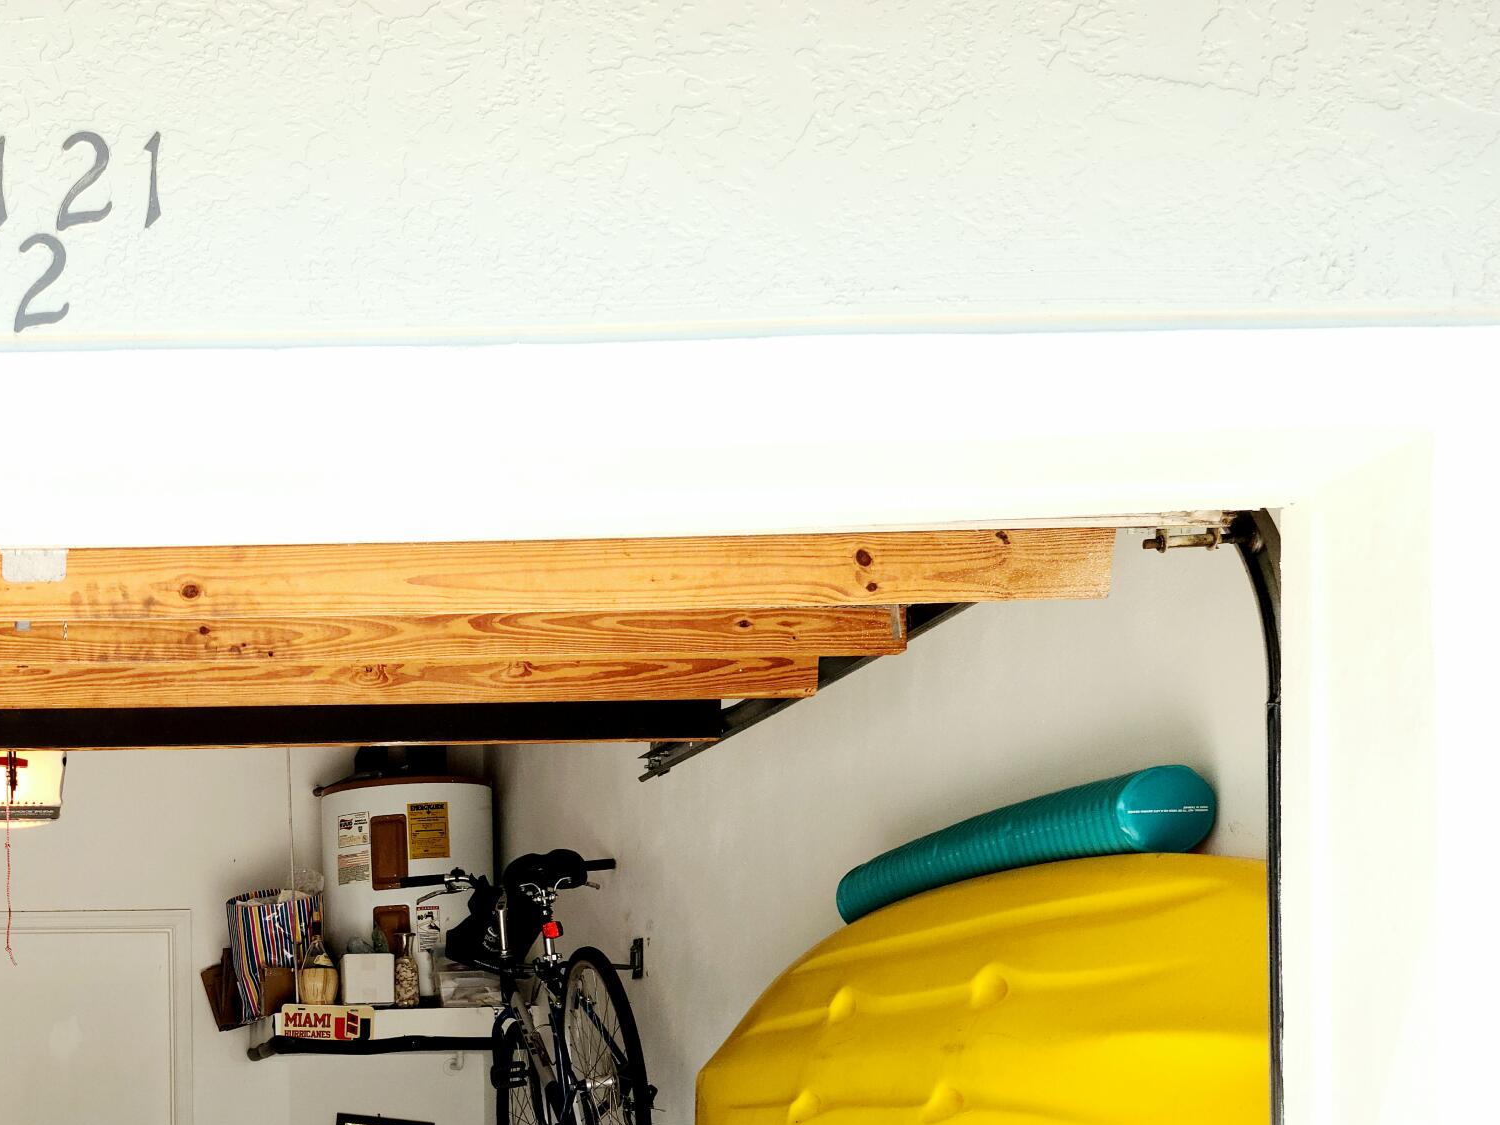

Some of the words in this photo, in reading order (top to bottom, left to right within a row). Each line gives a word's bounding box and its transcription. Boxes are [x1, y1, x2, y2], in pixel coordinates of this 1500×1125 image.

[13, 233, 70, 333] 2
[284, 1012, 331, 1028] MIAMI
[284, 1030, 330, 1038] HURRICANES
